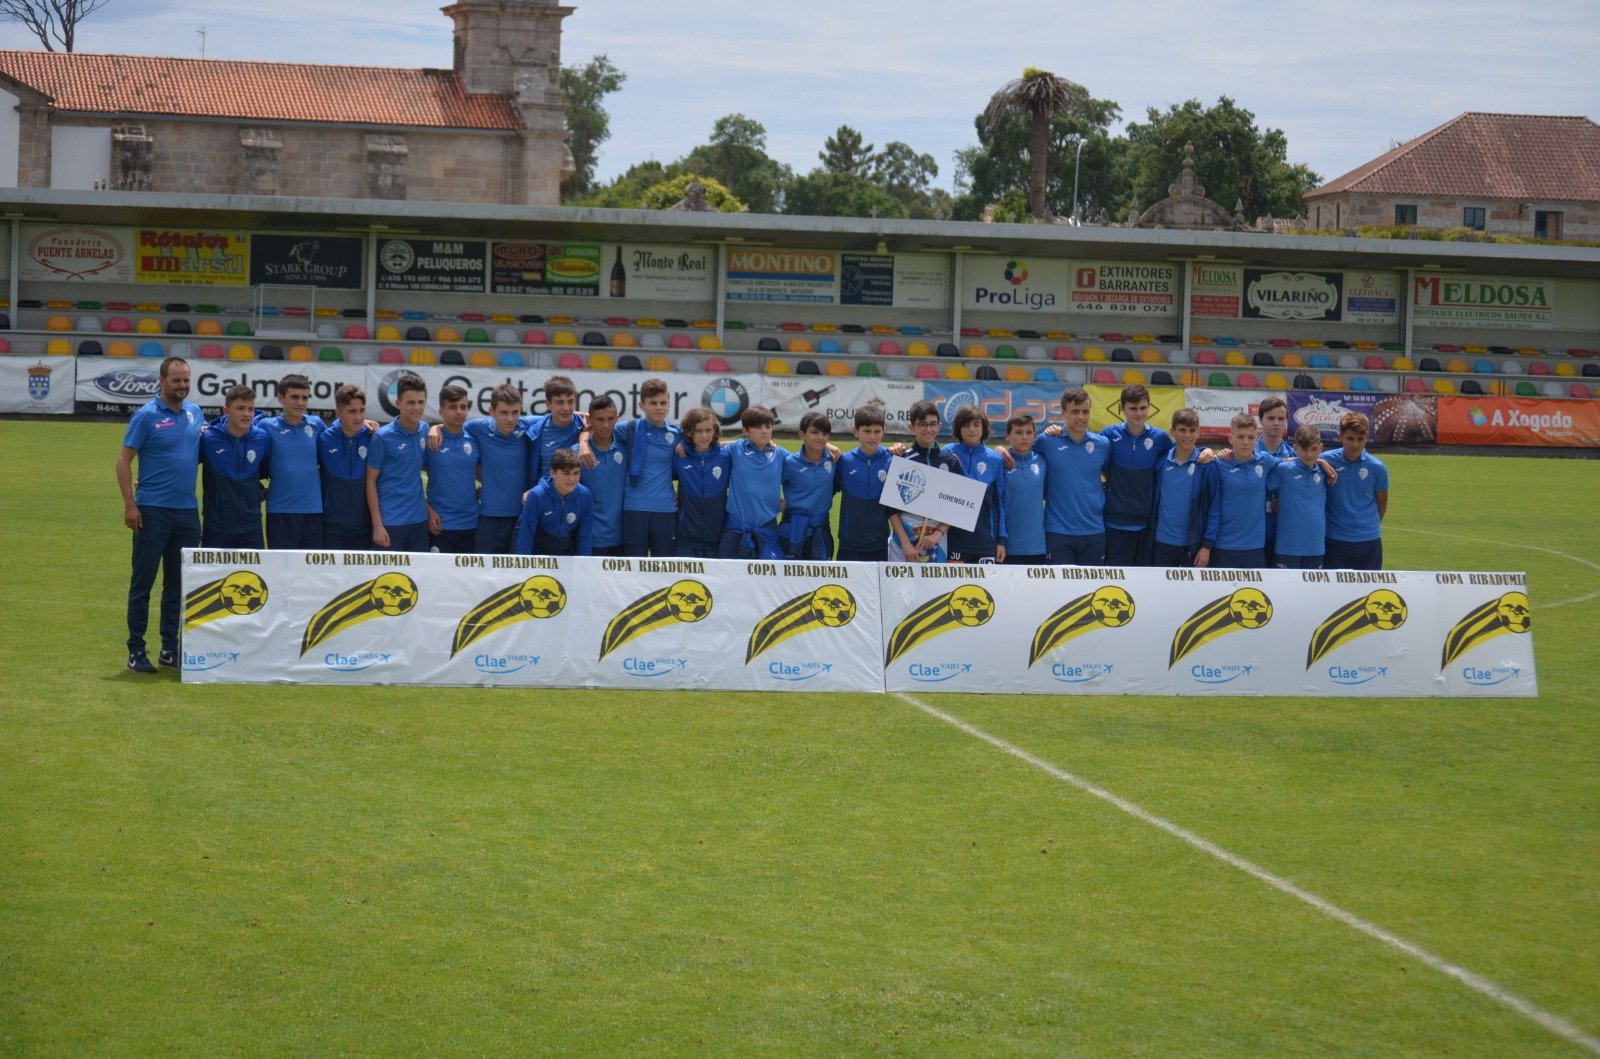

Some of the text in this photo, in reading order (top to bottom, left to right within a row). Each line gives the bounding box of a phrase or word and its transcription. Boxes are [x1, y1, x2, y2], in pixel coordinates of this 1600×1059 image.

[38, 246, 114, 259] PUENTE ARNELAS
[433, 242, 463, 254] M&M
[151, 254, 245, 273] marsil
[417, 257, 483, 271] PELUQUEROS
[633, 249, 706, 272] Monte Real
[729, 252, 832, 272] MONTINO
[265, 262, 347, 277] STARK GROUP
[1099, 266, 1172, 279] EXTINTORES
[1192, 266, 1237, 285] MELDOSA
[1099, 280, 1169, 292] BARRANTES
[1414, 277, 1548, 306] MELDOSA
[975, 287, 1056, 310] ProLiga
[1130, 295, 1138, 303] DE
[1139, 295, 1171, 304] EXTINTORES
[1256, 288, 1329, 303] VILARIÑO
[1110, 303, 1136, 311] 838
[1142, 304, 1167, 312] 074
[1413, 309, 1453, 317] MONTAJES
[1455, 310, 1502, 318] ELECTRICOS
[109, 373, 160, 393] Ford
[707, 378, 745, 395] BMW
[1491, 409, 1573, 432] A Xogada
[938, 492, 965, 506] OURENSE
[193, 551, 261, 565] RIBADUMIA
[306, 553, 410, 566] COPA RIBADUMIA
[455, 556, 559, 569] COPA RIBADUMIA
[602, 559, 705, 573] COPA RIBADUMIA
[747, 564, 848, 578] COPA RIBADUMIA
[885, 566, 985, 579] COPA RIBADUMIA
[1027, 567, 1125, 580] COPA RIBADUMIA
[1166, 569, 1263, 582] COPA RIBADUMIA
[1302, 571, 1397, 584] COPA RIBADUMIA
[1436, 573, 1464, 585] COPA
[184, 651, 205, 665] lae
[325, 653, 357, 665] Clae
[475, 655, 507, 667] Clae
[623, 658, 655, 670] Clae
[769, 662, 799, 674] Clae
[909, 663, 940, 676] Clae
[1052, 663, 1082, 676] Clae
[1191, 665, 1221, 677] Clae
[1328, 666, 1357, 679] Clae
[1463, 667, 1491, 679] Clae
